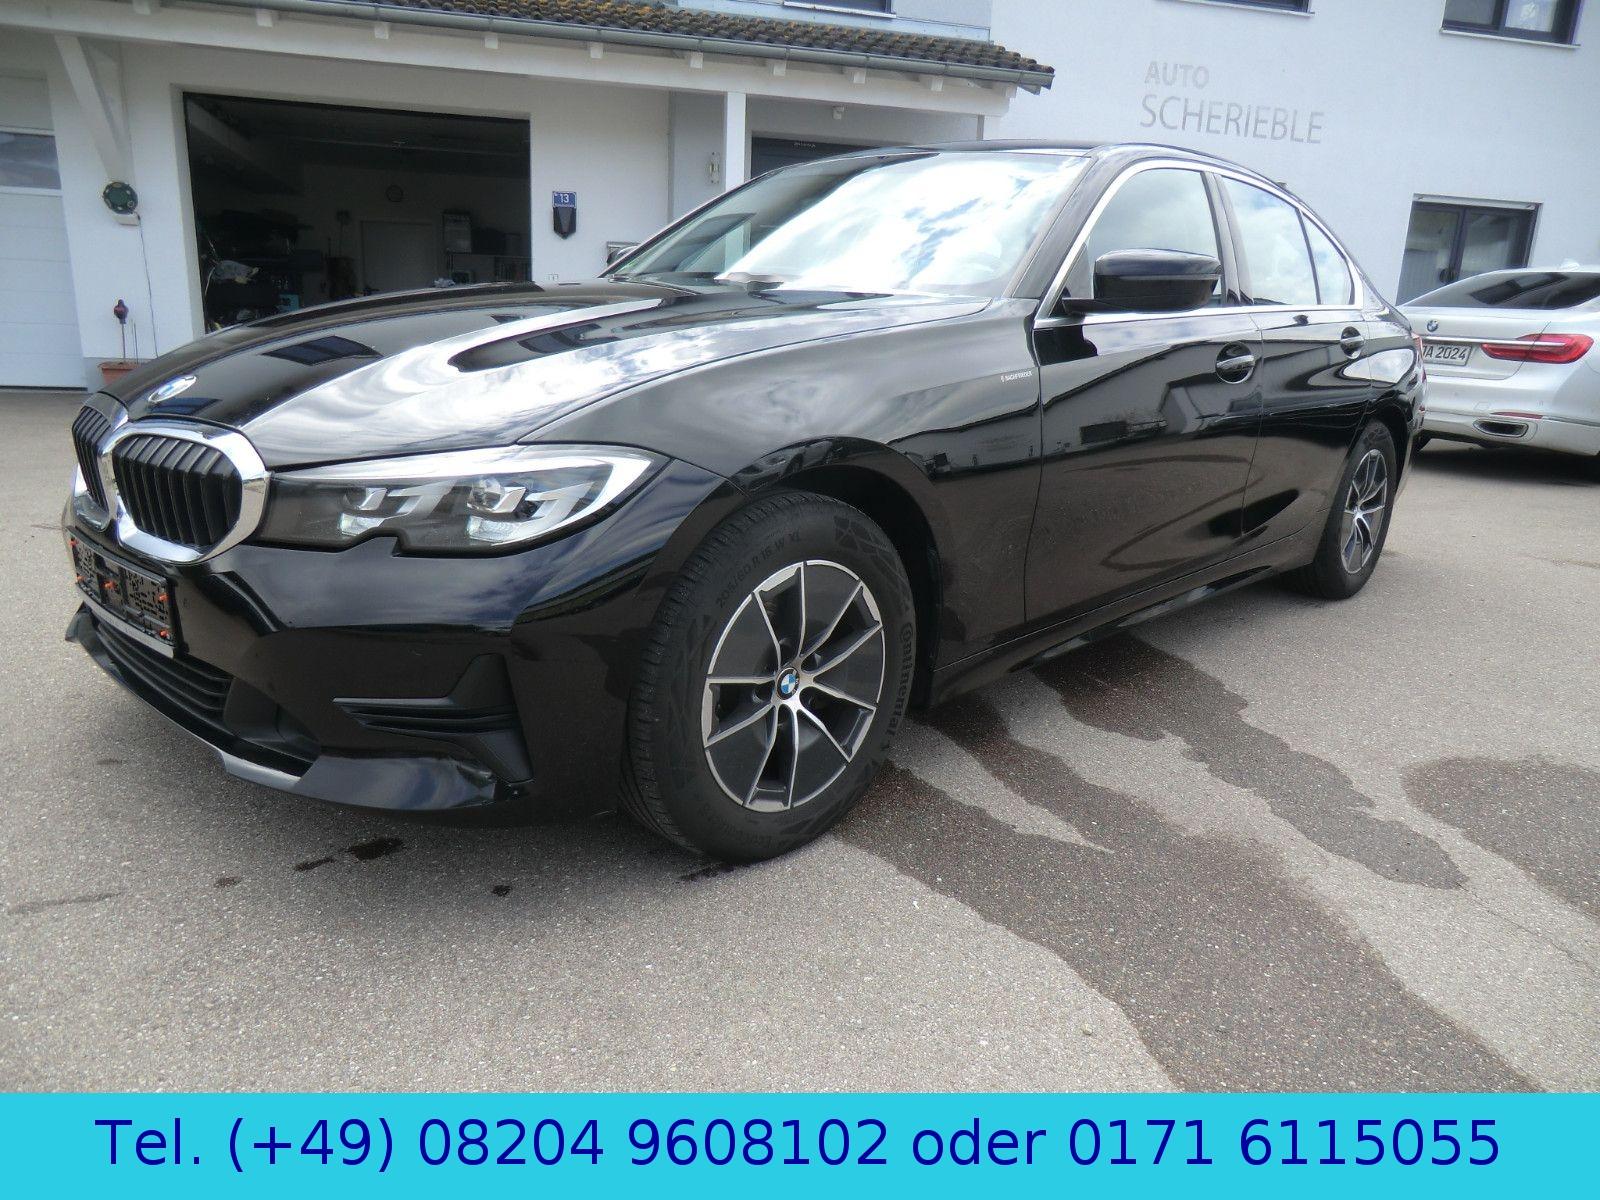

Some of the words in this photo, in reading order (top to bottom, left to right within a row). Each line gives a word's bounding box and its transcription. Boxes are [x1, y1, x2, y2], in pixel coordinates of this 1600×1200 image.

[1143, 60, 1210, 90] AUTO
[1139, 93, 1325, 144] SCHERIEBLE
[559, 193, 570, 203] 13
[1435, 345, 1467, 360] 2024
